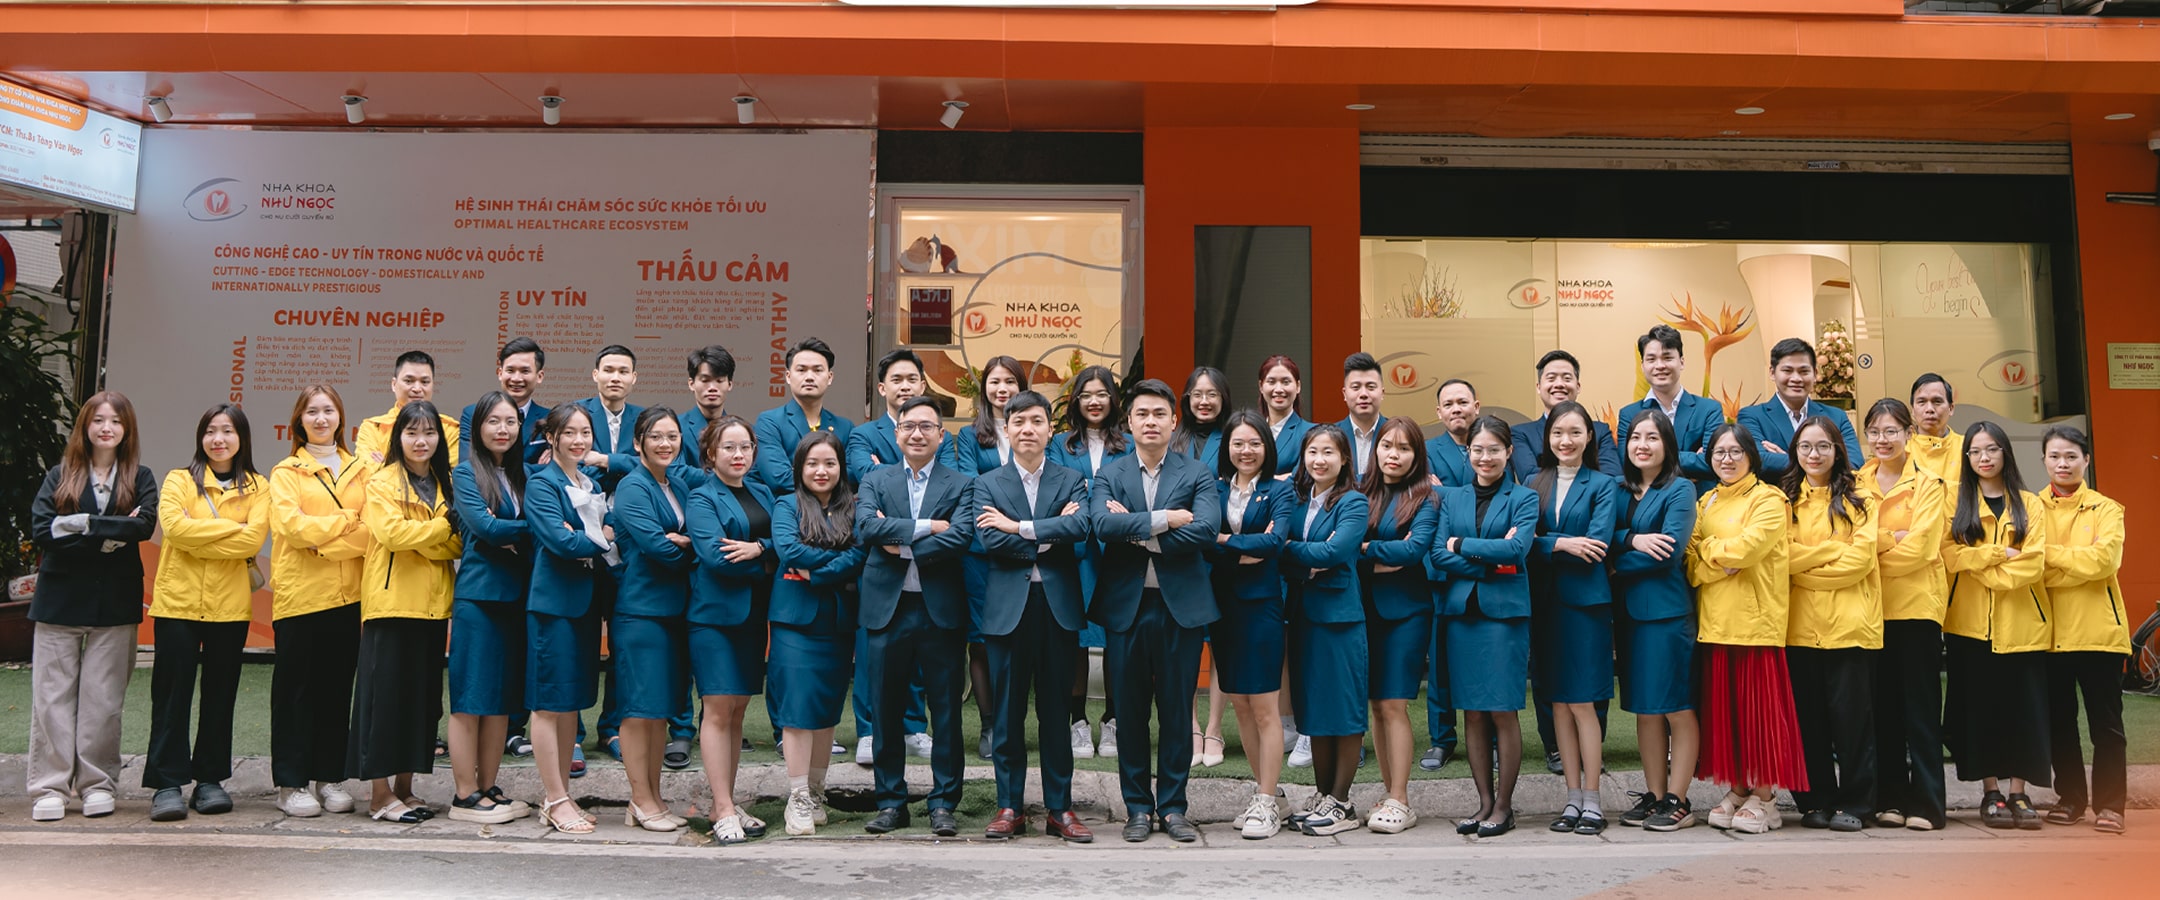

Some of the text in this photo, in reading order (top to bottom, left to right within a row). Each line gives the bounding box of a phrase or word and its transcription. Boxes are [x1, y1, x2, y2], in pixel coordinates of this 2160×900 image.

[262, 184, 336, 193] NHA KHOA
[262, 196, 335, 212] NHƯ NGỌC
[455, 196, 766, 213] HỆ SINH THÁI CHĂM SÓC SỨC KHỎE TỐI ƯU
[454, 219, 689, 231] OPTIMAL HEALTHCARE ECOSYSTEM
[214, 243, 250, 259] CÔNG
[254, 244, 289, 262] NGHỆ
[292, 248, 319, 259] CAO
[332, 248, 349, 260] UY
[353, 245, 374, 260] TÍN
[378, 248, 422, 261] TRONG
[425, 246, 462, 261] NƯỚC
[466, 247, 484, 261] VÀ
[487, 244, 524, 263] QUỐC
[528, 244, 544, 262] TẾ
[213, 266, 258, 276] CUTTING
[268, 267, 296, 277] EDGE
[298, 268, 370, 278] TECHNOLOGY
[379, 268, 459, 279] DOMESTICALLY
[462, 270, 485, 280] AND
[637, 248, 789, 282] THẤU CẢM
[212, 281, 381, 293] INTERNATIONALLY PRESTIGIOUS
[1558, 279, 1612, 288] NHA KHOA
[517, 286, 587, 306] UY TÍN
[1558, 289, 1614, 301] NHƯ NGỌC
[1006, 303, 1080, 312] NHA KHOA
[274, 306, 445, 331] CHUYÊN NGHIỆP
[1004, 314, 1082, 332] NHƯ NGỌC
[769, 292, 788, 398] EMPATHY
[230, 336, 247, 410] SIONAL
